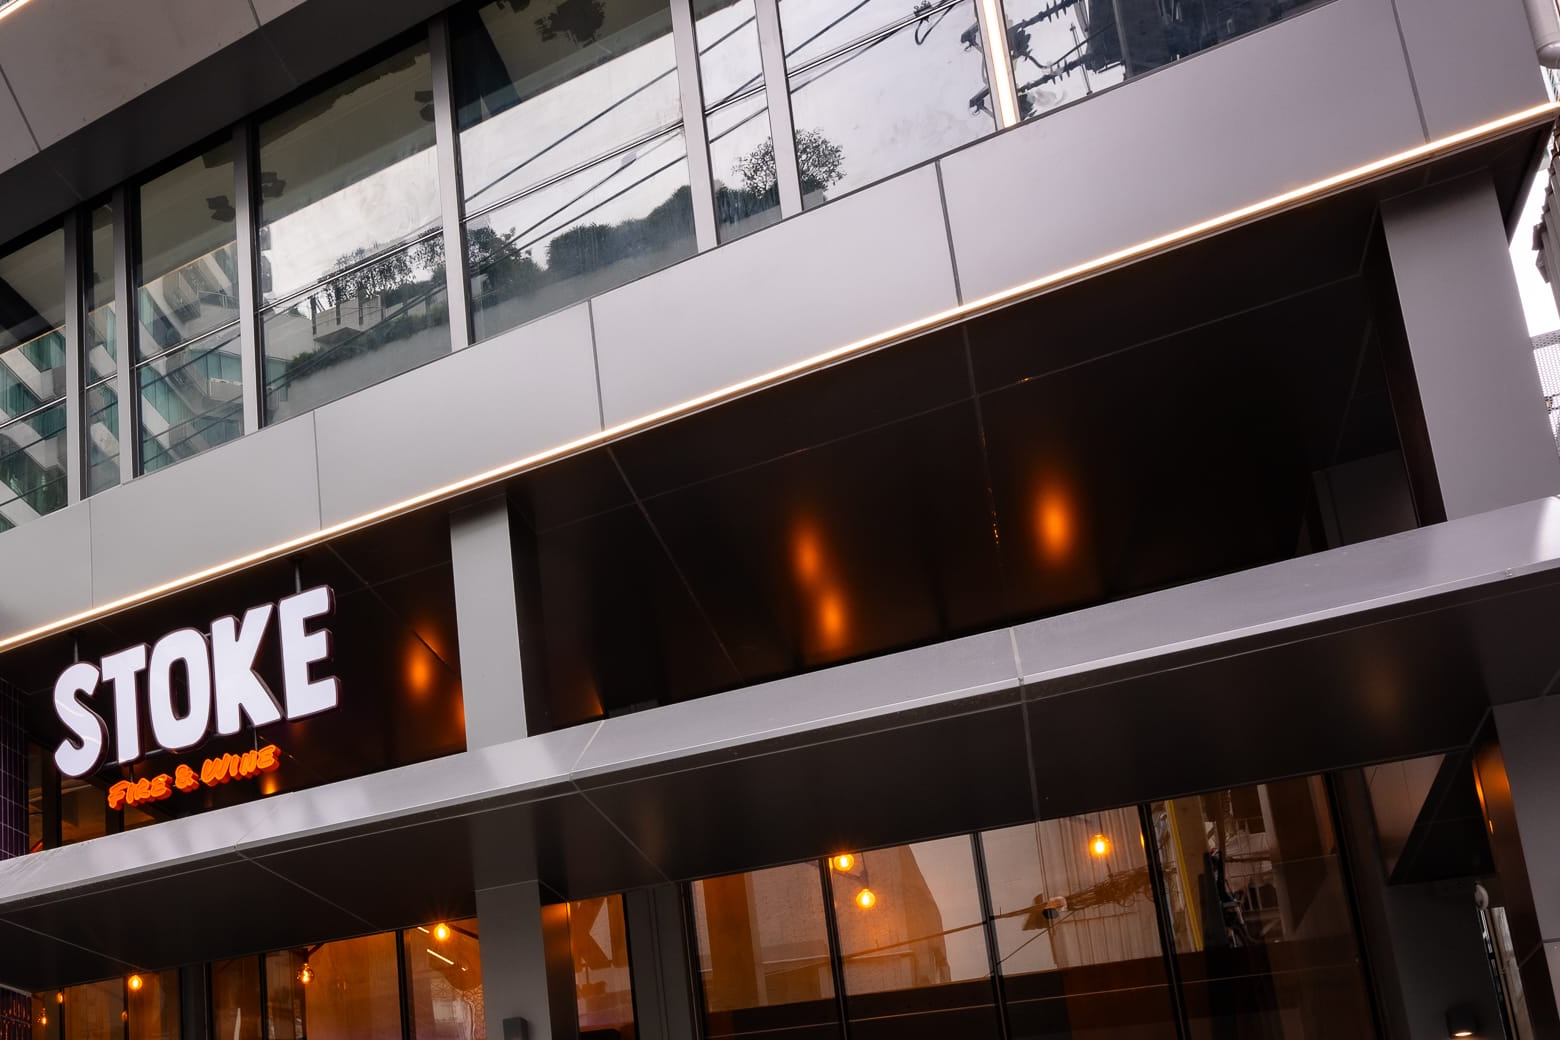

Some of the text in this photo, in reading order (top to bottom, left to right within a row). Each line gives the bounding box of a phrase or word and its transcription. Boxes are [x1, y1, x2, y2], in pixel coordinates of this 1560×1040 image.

[54, 585, 339, 776] STOKE
[108, 744, 281, 811] FIRE & WINE
